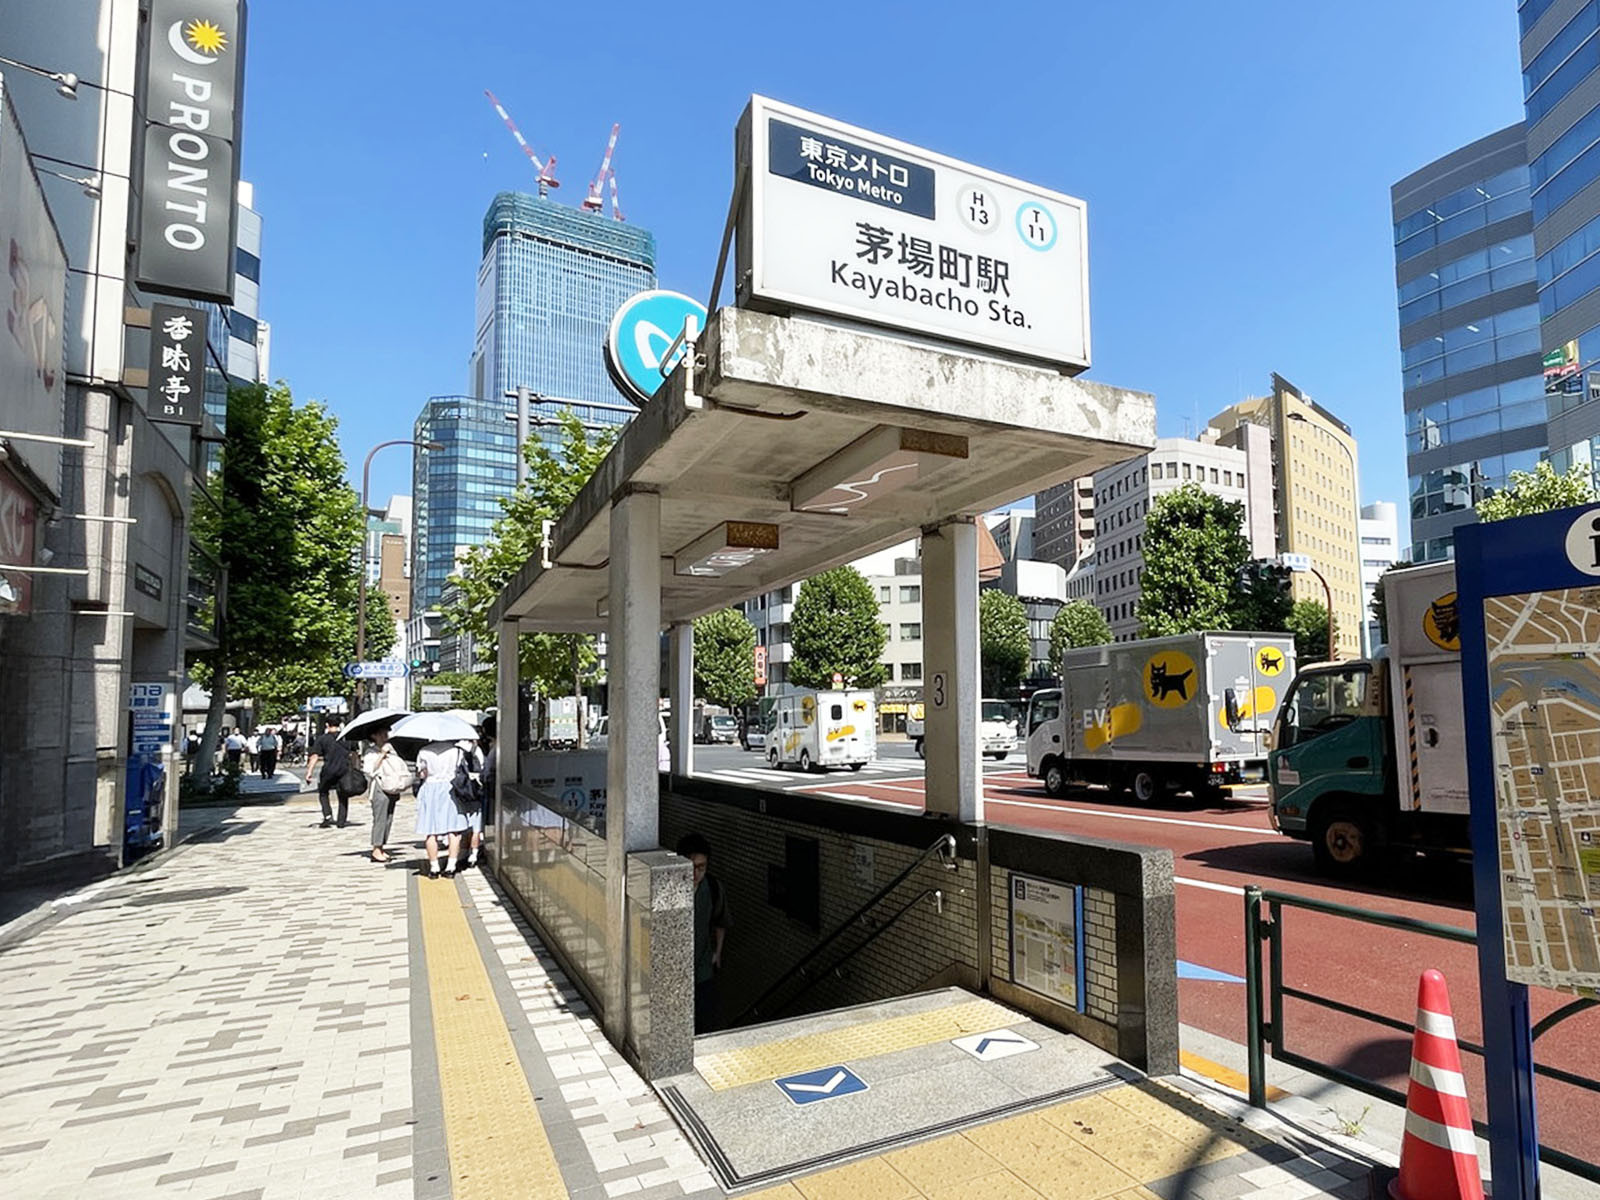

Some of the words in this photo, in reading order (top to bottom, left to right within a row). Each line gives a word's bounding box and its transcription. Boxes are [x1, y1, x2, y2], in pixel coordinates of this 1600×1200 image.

[163, 72, 212, 252] PRONTO
[799, 135, 910, 188] 東京メトロ
[807, 162, 854, 192] Tokyo
[858, 178, 903, 205] Metro
[972, 191, 984, 206] H
[968, 206, 989, 226] 13
[1028, 224, 1046, 242] 11
[1032, 210, 1041, 223] T
[855, 220, 1011, 298] 茅場町駅
[830, 260, 980, 318] Kayabacho
[988, 299, 1033, 330] Sta.
[160, 314, 194, 403] 香味亭
[934, 675, 945, 706] 3
[1083, 708, 1106, 729] EV
